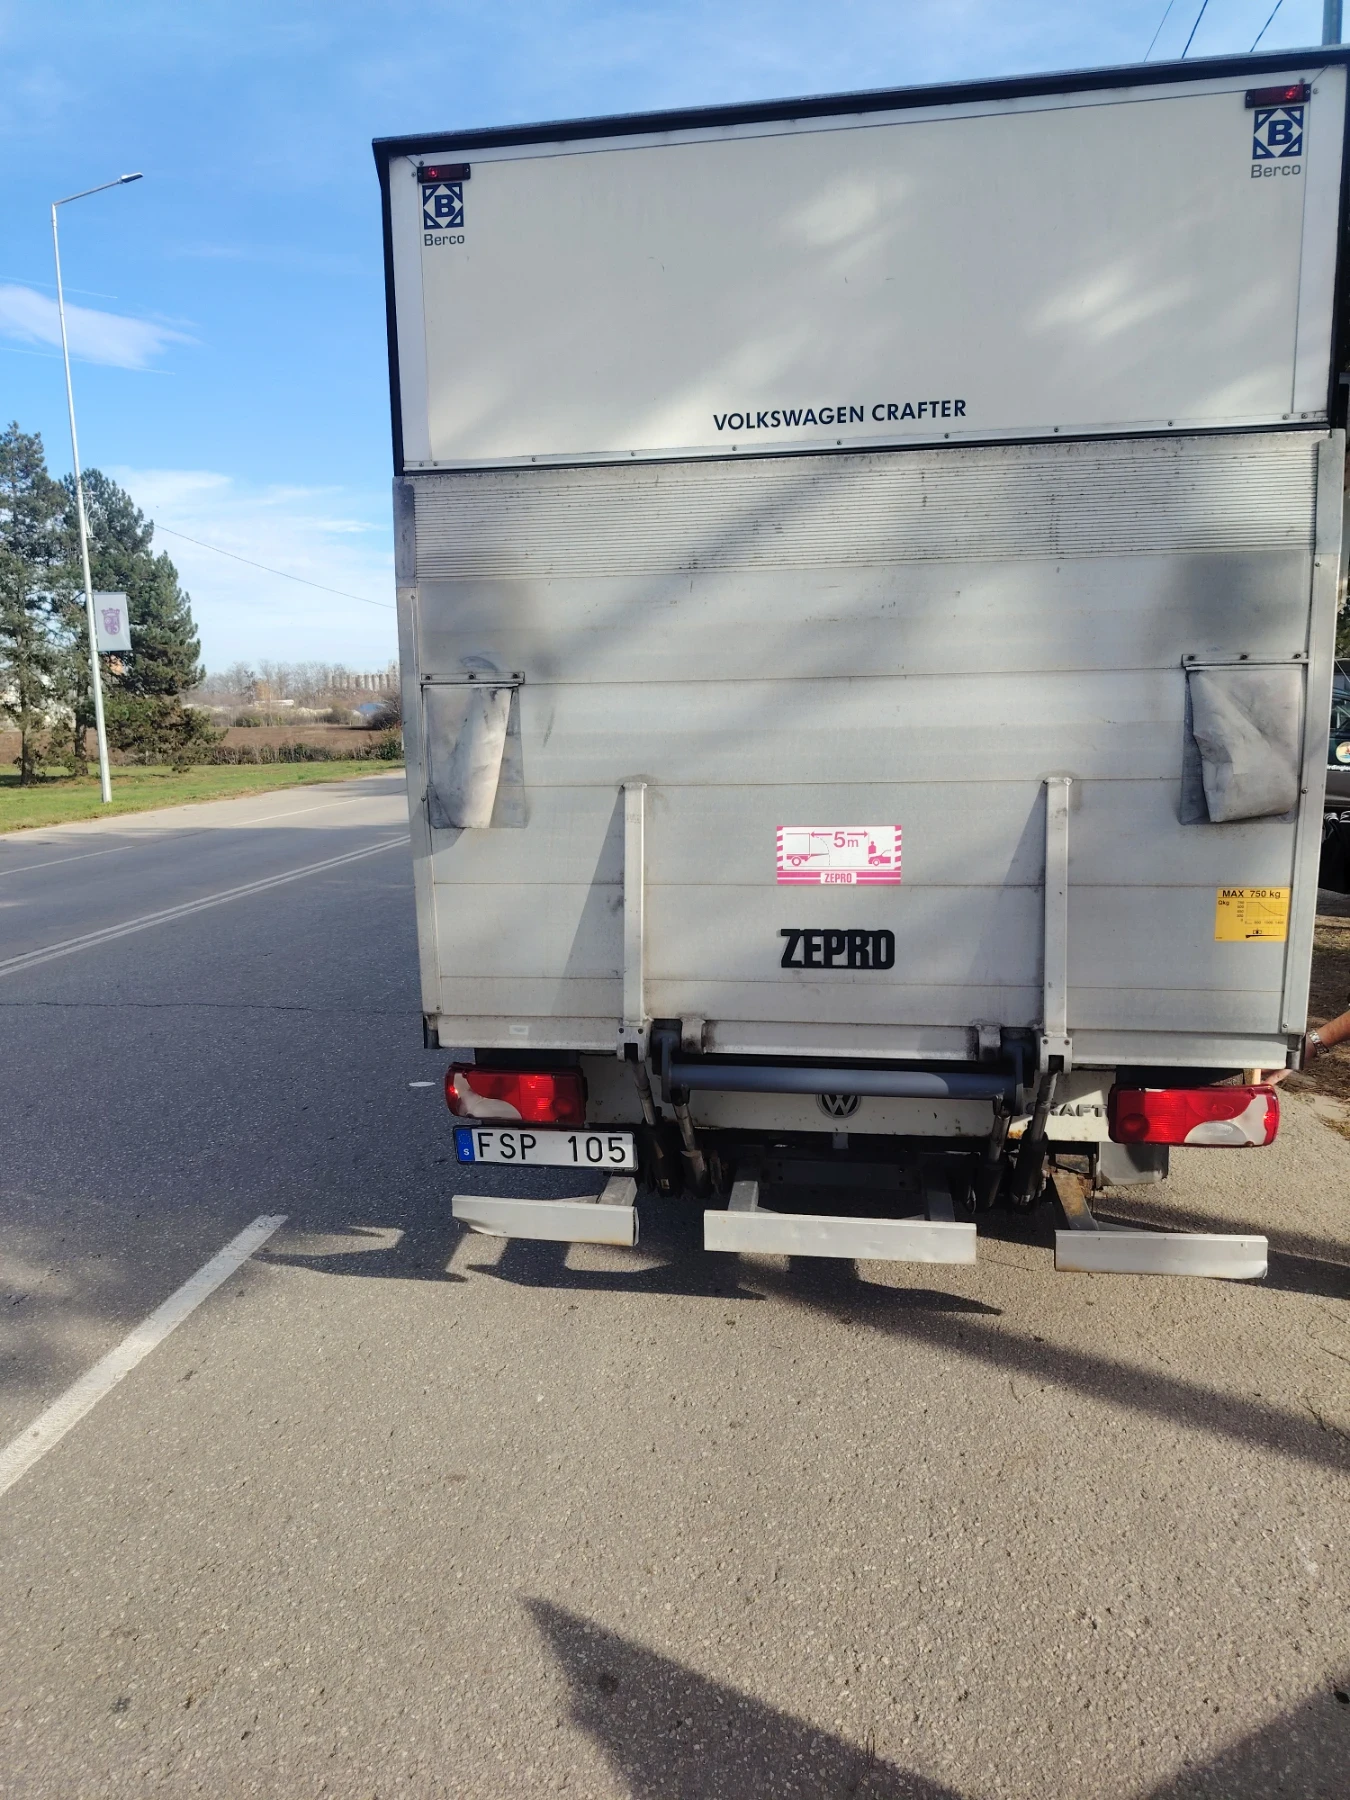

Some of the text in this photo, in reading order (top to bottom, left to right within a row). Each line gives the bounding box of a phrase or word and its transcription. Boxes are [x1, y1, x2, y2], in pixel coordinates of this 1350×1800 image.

[1267, 120, 1293, 146] B
[1251, 164, 1301, 179] Berco
[434, 194, 456, 218] B
[424, 233, 465, 247] Berco
[713, 399, 967, 431] VOLKSWAGEN CRAFTER
[824, 873, 852, 883] ZEPRO
[1222, 890, 1281, 899] MAX 750 kg
[780, 928, 896, 970] ZEPRO
[463, 1148, 470, 1156] S
[477, 1132, 626, 1163] FSP 105
